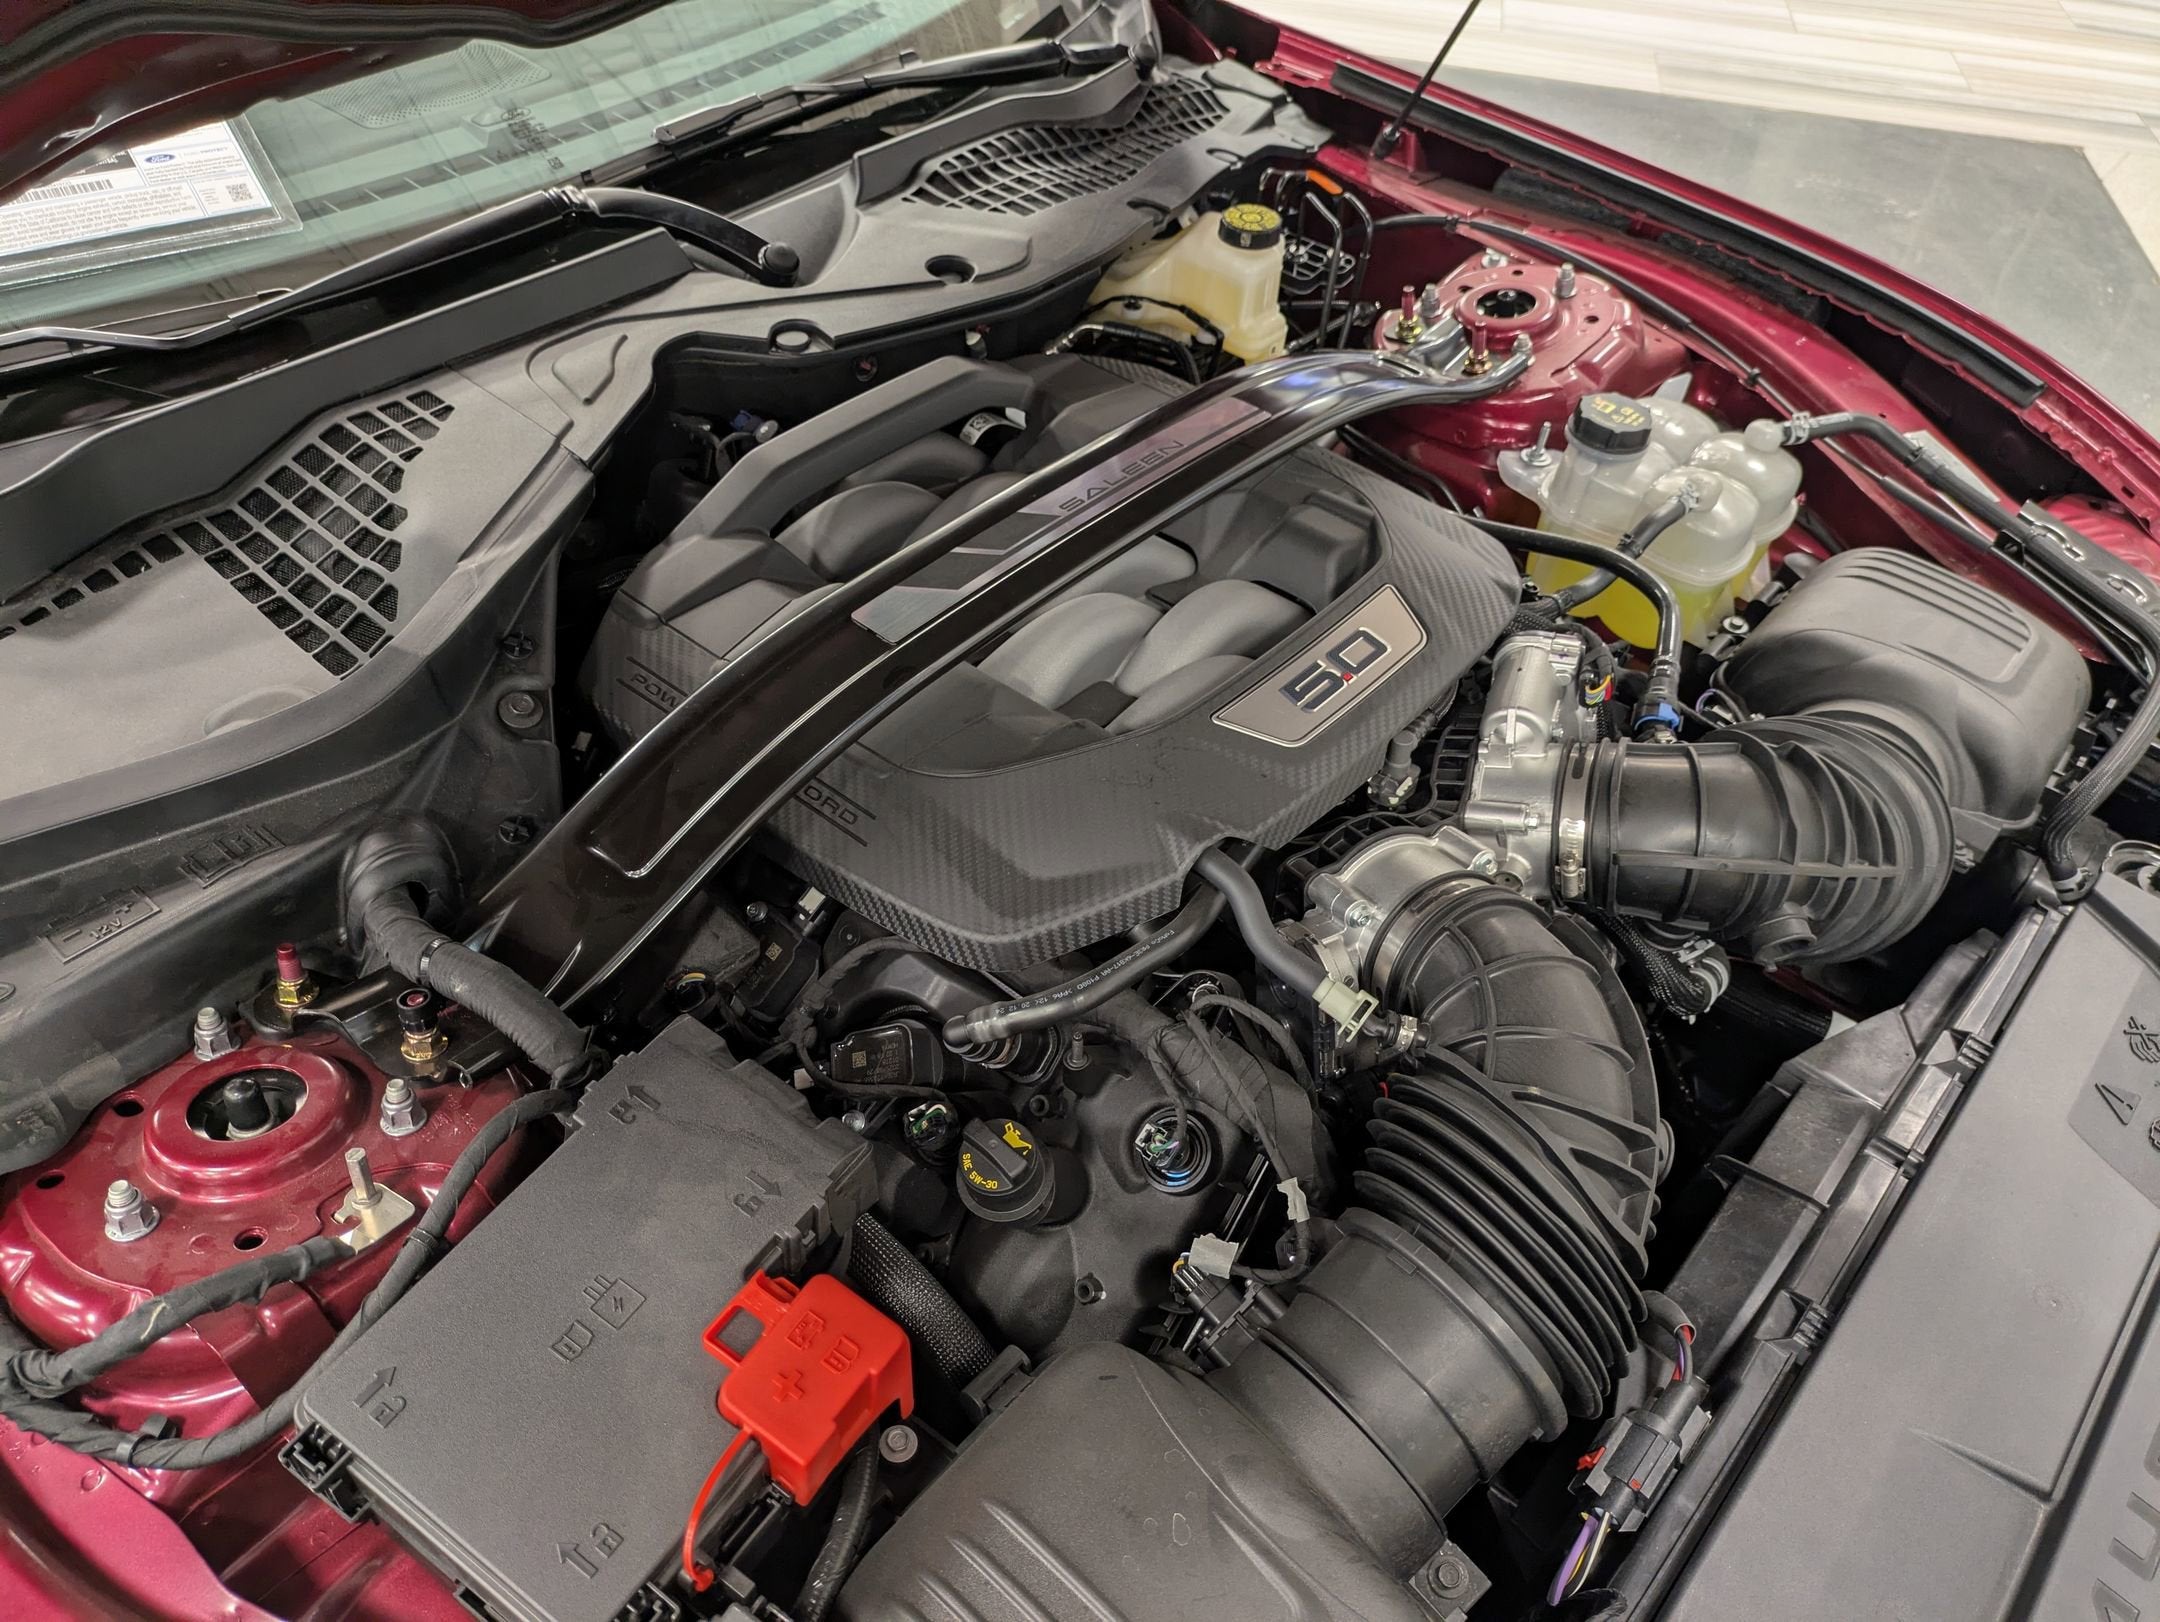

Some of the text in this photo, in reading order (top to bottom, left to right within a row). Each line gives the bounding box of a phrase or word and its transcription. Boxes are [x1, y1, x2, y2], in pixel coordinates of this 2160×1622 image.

[1059, 440, 1184, 513] SALEEN
[1279, 627, 1392, 713] 5.0
[630, 672, 680, 709] POW
[803, 785, 859, 825] ORD
[90, 917, 122, 940] 12V
[962, 1153, 998, 1189] SAE 5W-30
